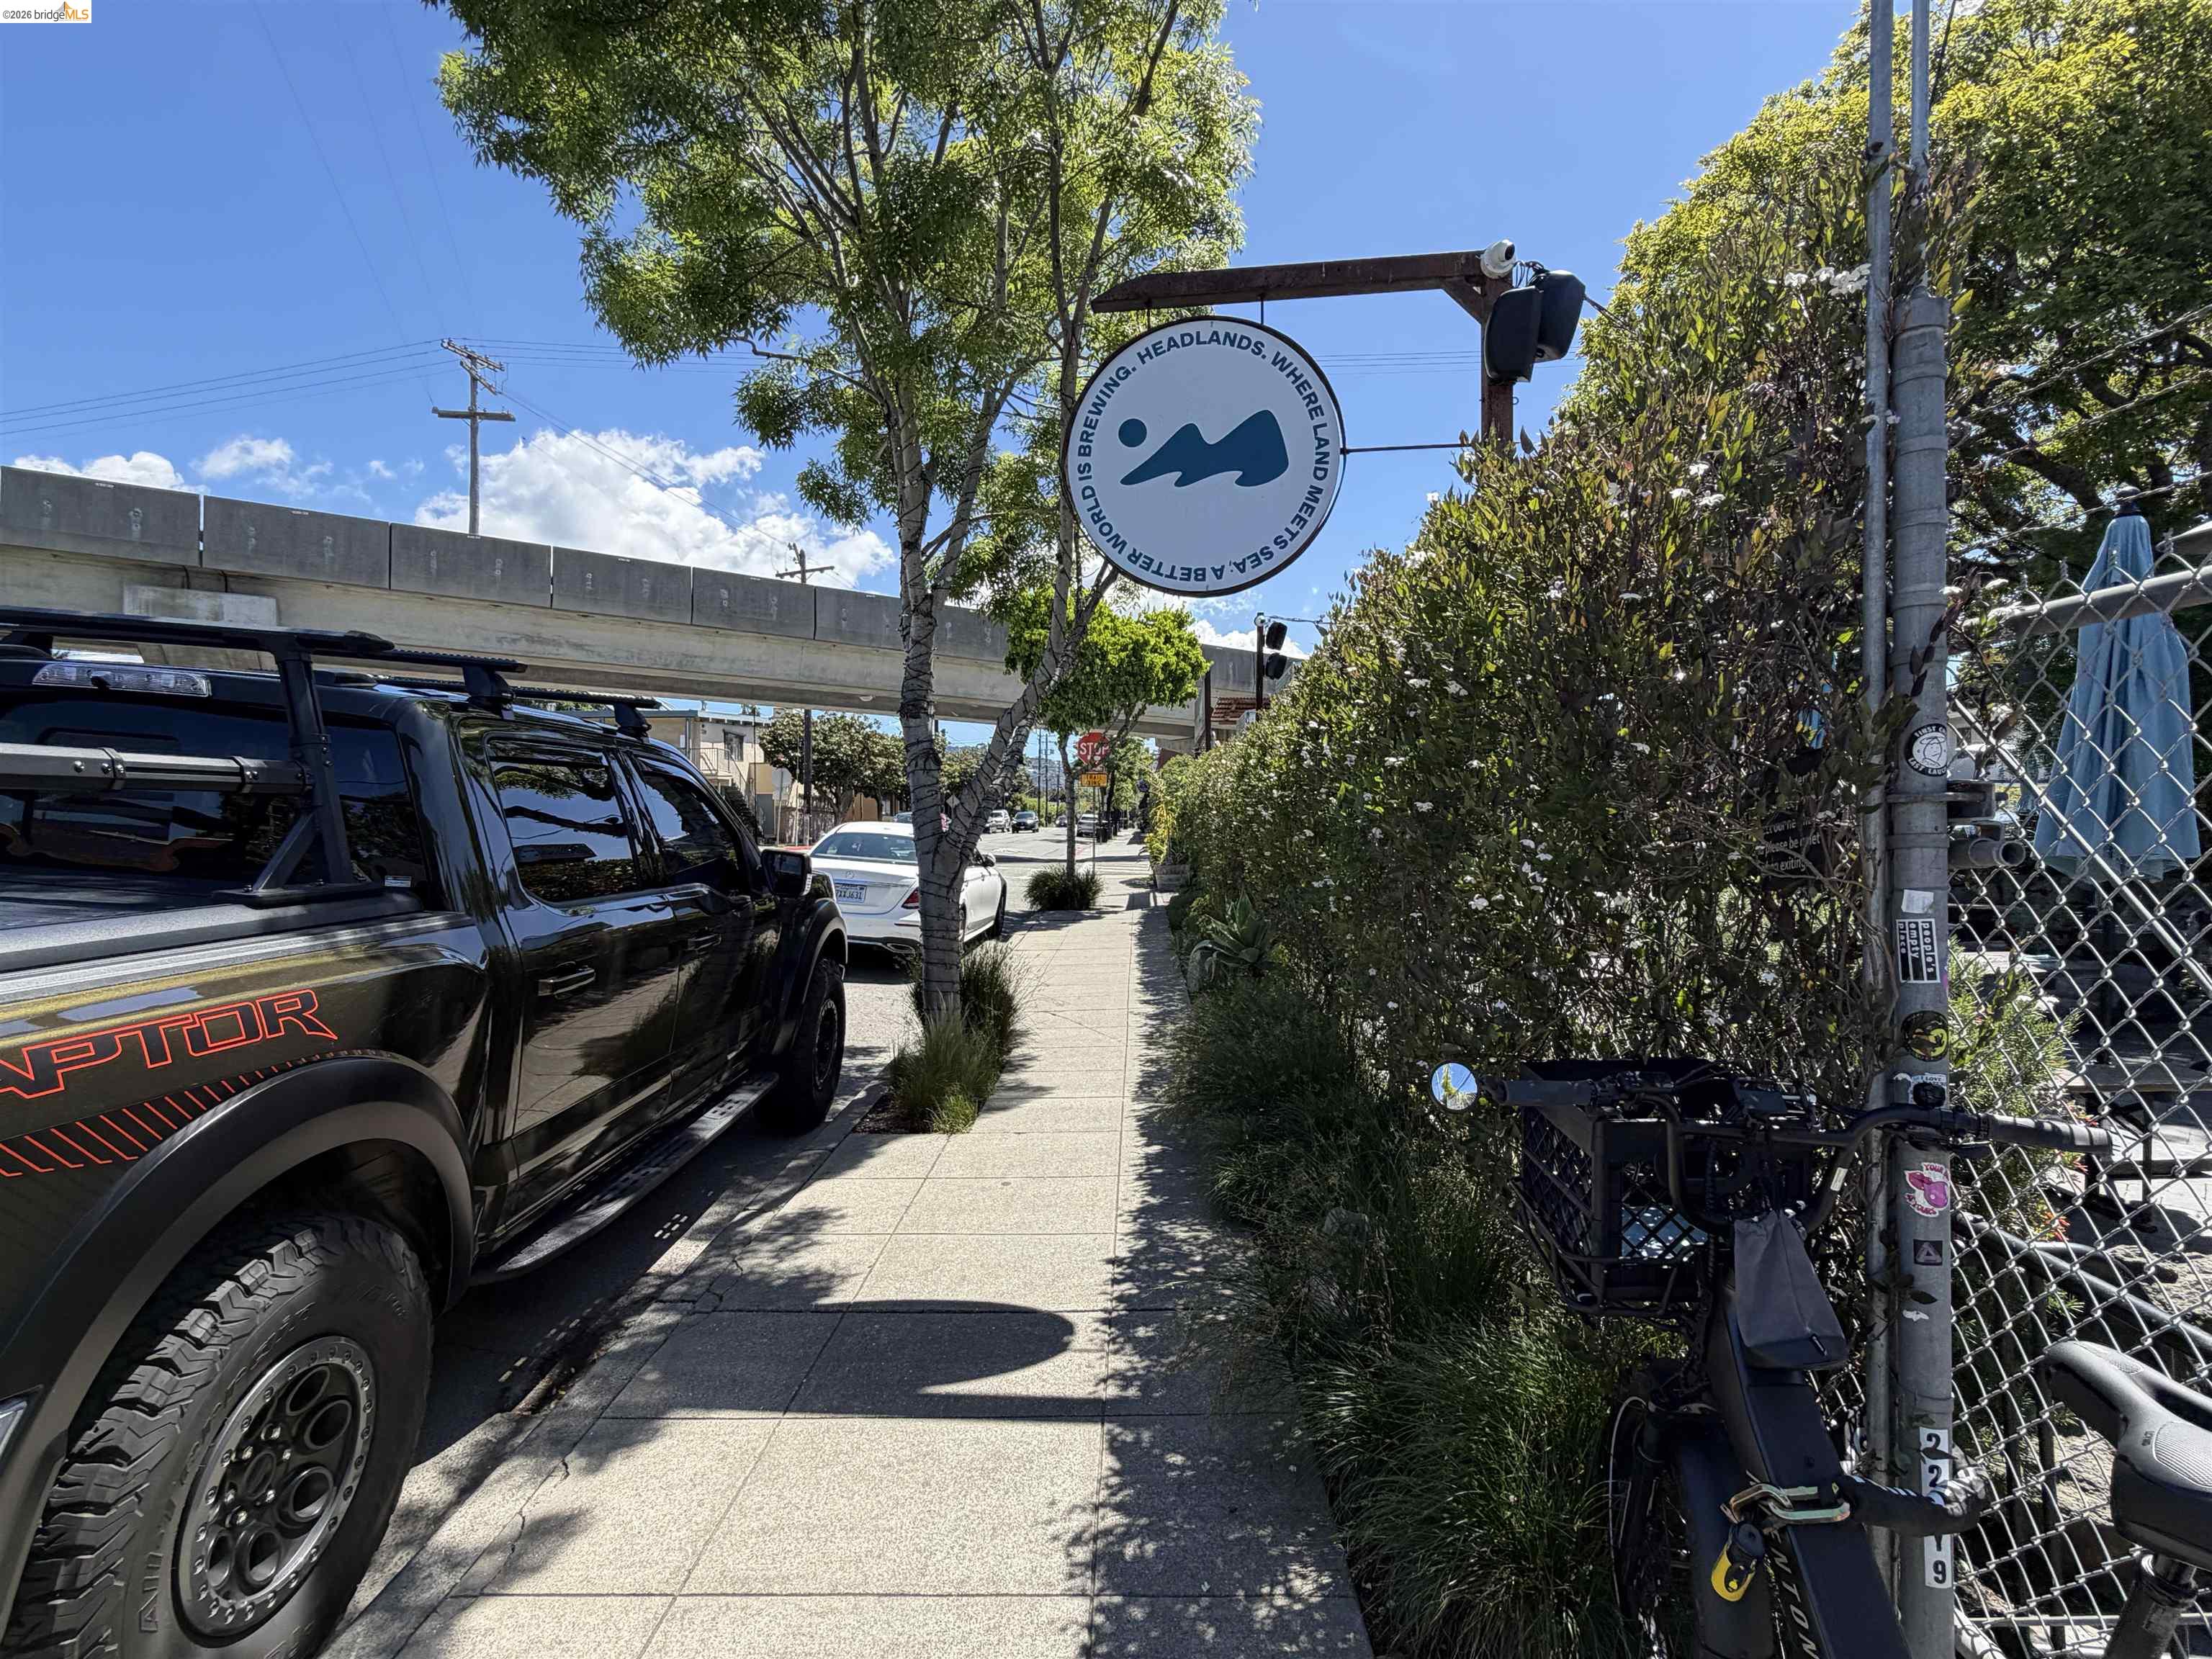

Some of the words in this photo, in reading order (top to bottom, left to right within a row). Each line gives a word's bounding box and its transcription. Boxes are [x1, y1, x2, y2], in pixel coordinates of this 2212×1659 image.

[1136, 330, 1267, 365] HEADLANDS.
[1270, 350, 1324, 421] WHERE
[1078, 365, 1137, 458] BREWING.
[1312, 422, 1330, 482] LAND
[1077, 462, 1092, 482] IS
[1081, 485, 1128, 555] WORLD
[1273, 484, 1325, 550] MEETS
[1127, 547, 1208, 583] BETTER
[1210, 565, 1226, 580] A
[1080, 742, 1110, 755] STOP
[1907, 757, 1925, 771] LAST
[1897, 922, 1907, 954] place
[1909, 922, 1920, 959] empty
